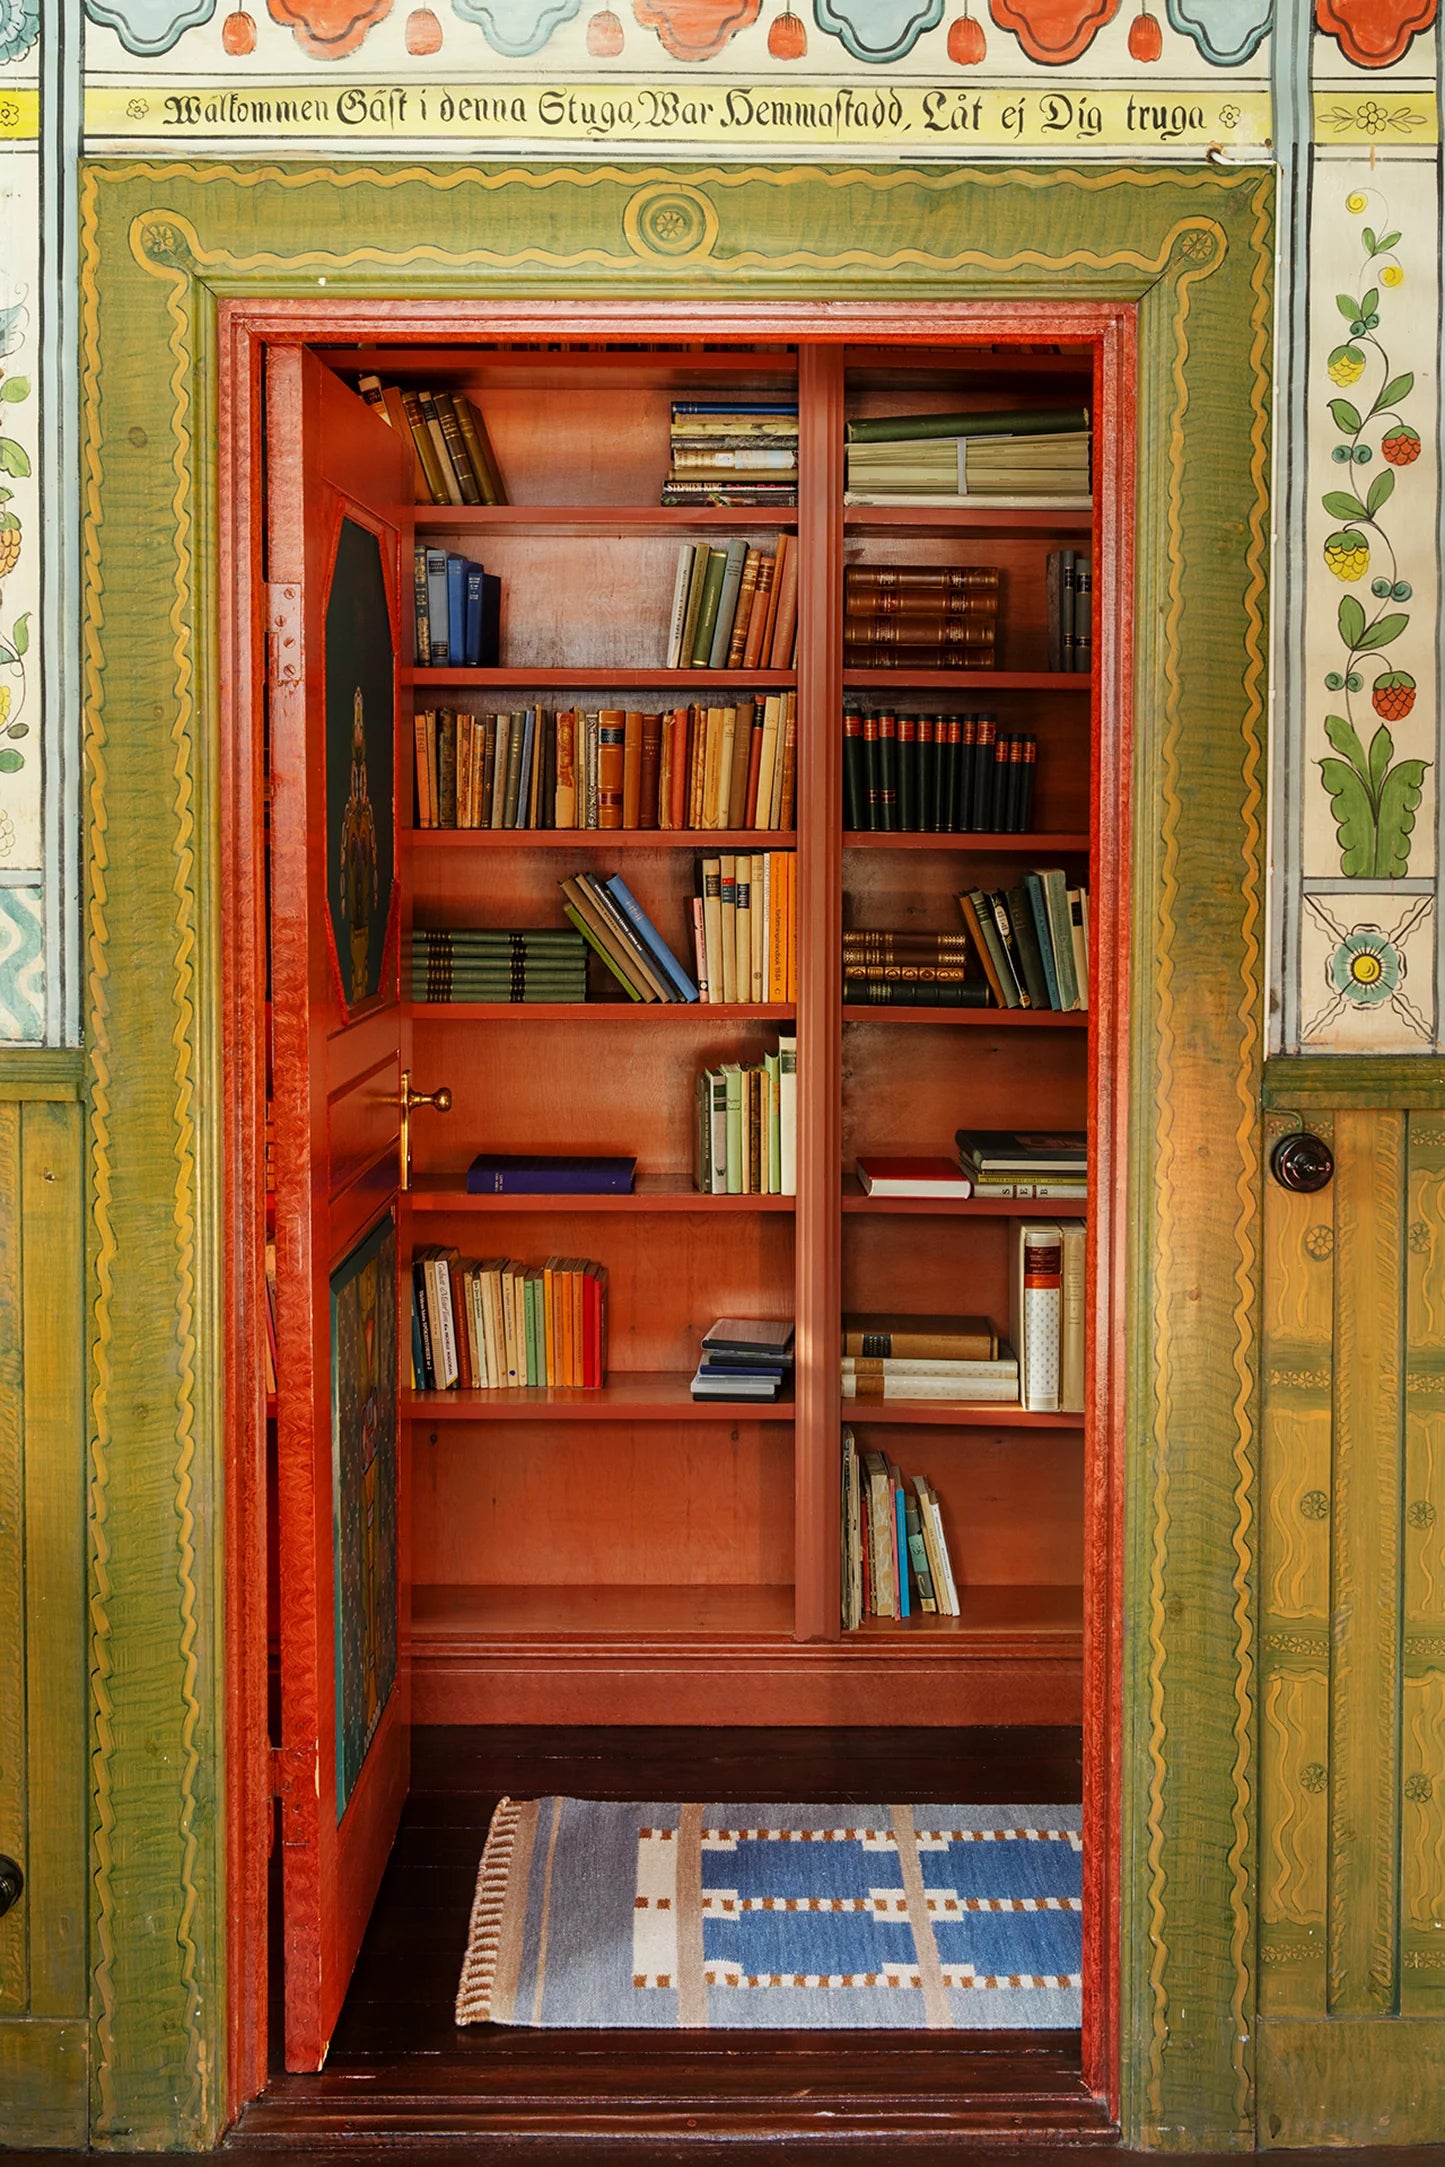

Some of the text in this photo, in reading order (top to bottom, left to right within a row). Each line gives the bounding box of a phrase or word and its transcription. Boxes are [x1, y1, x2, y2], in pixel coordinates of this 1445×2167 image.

[420, 89, 428, 121] i
[440, 88, 528, 122] denna
[538, 88, 642, 135] Stuga,
[637, 90, 715, 127] War
[922, 90, 983, 131] Låt
[1001, 97, 1026, 139] ej
[1039, 94, 1103, 137] Dig
[1127, 94, 1206, 141] truga
[667, 482, 702, 492] STEPHEN
[703, 482, 722, 492] KING
